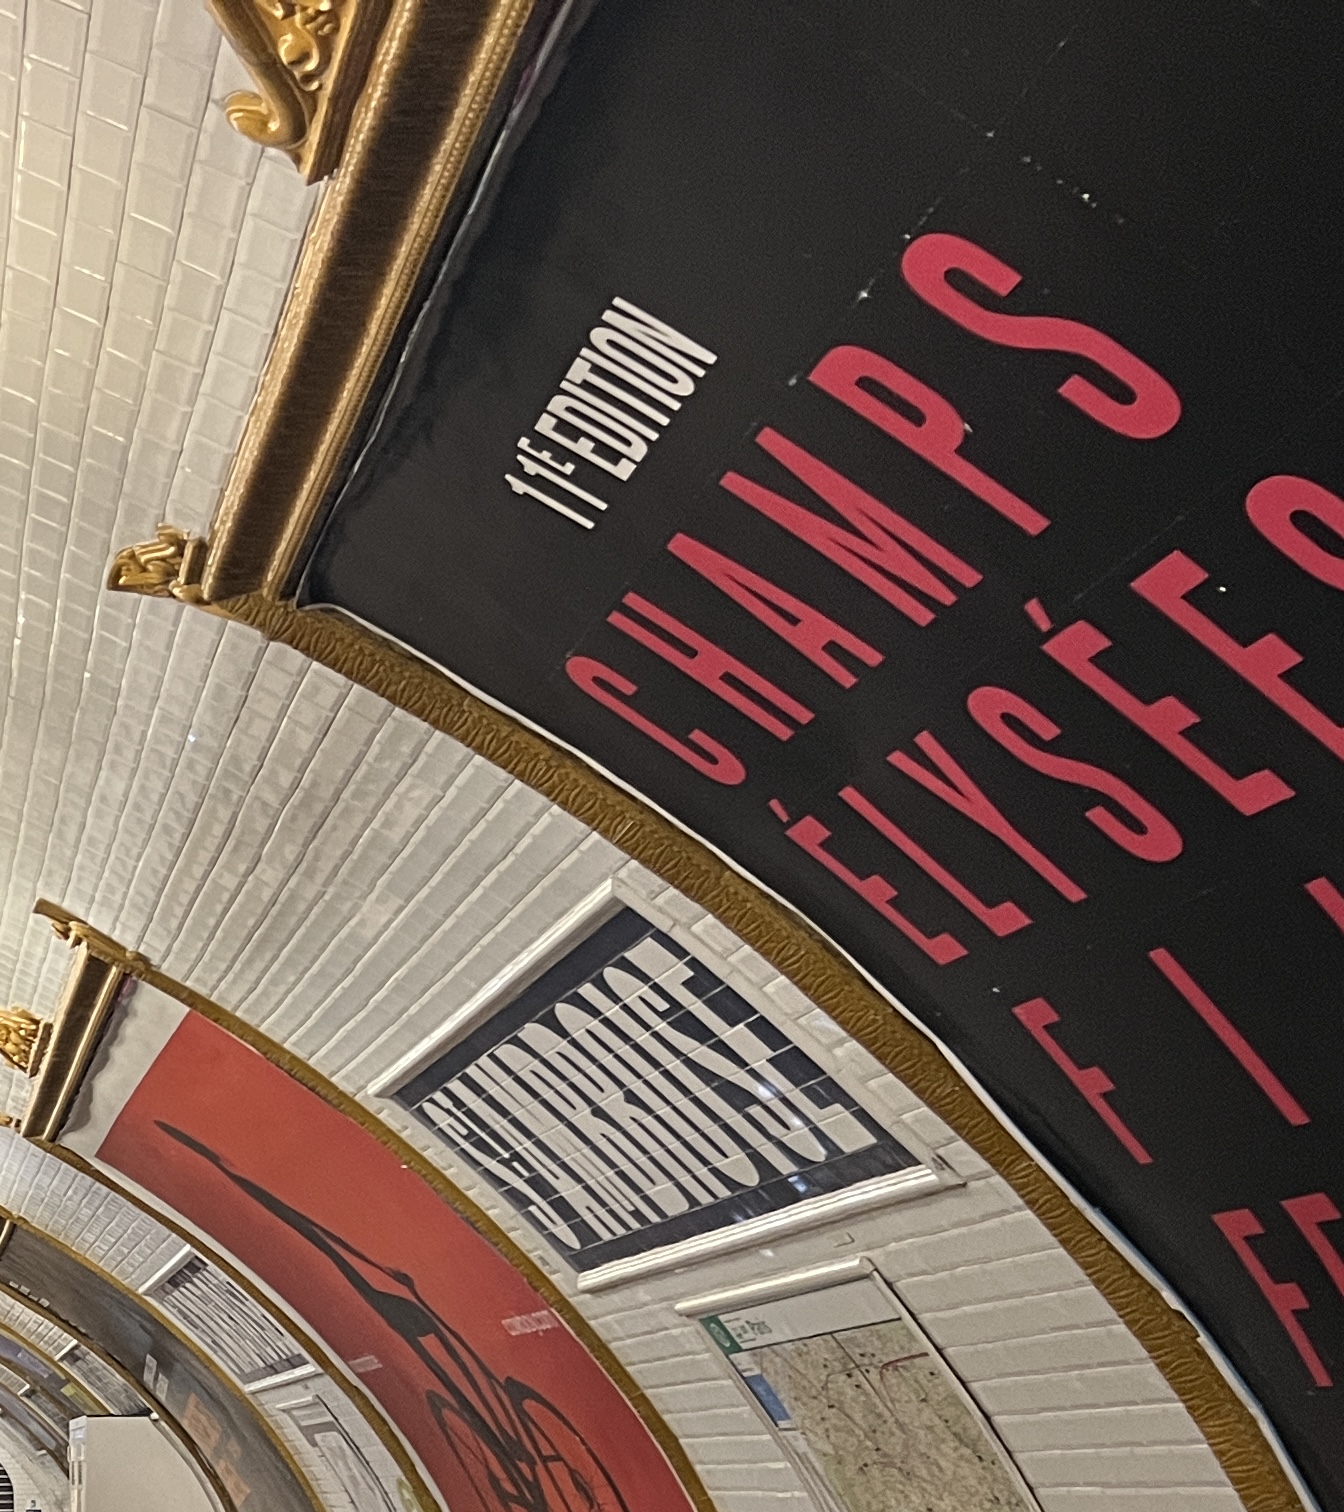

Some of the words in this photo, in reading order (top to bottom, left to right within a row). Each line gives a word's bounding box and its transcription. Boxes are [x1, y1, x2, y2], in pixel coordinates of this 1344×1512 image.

[534, 296, 718, 482] EDITION
[565, 232, 1182, 785] CHAMPS
[442, 937, 878, 1242] AMBROISE
[1012, 876, 1344, 1164] FI
